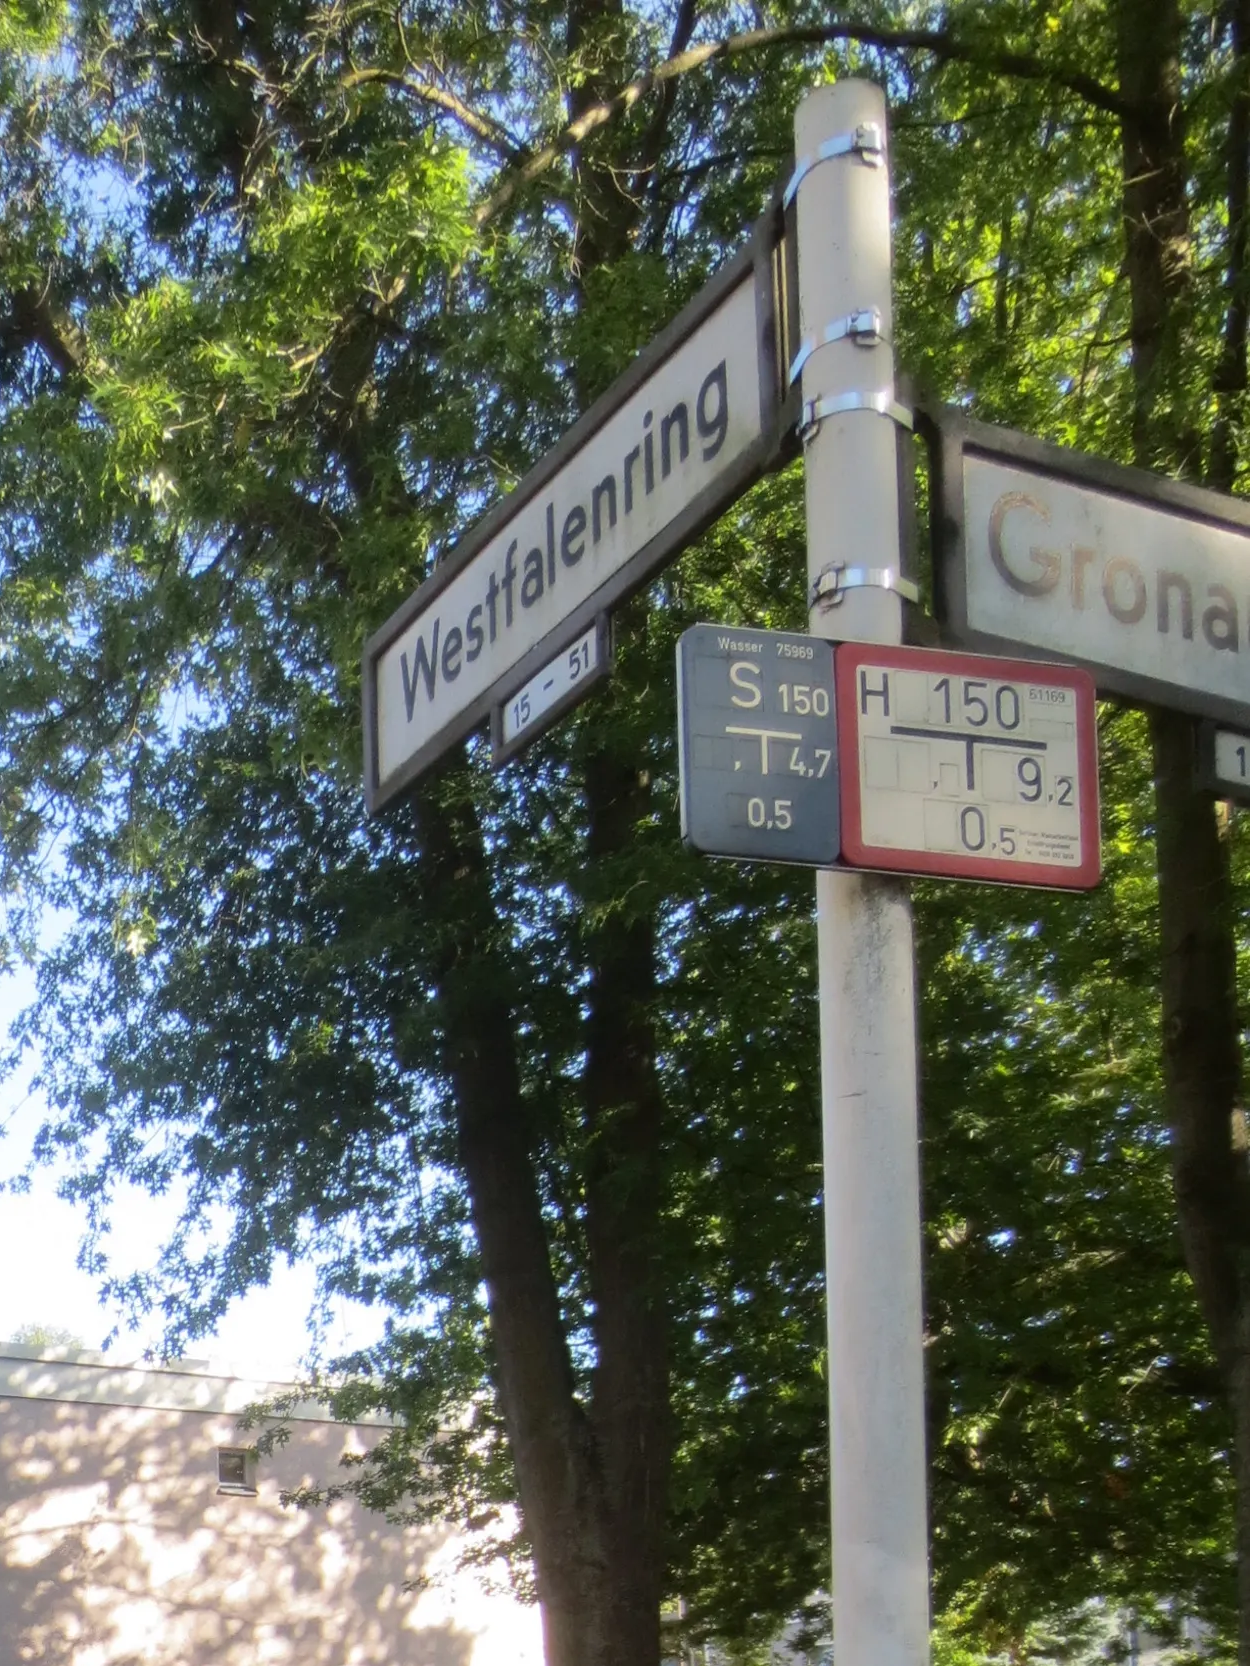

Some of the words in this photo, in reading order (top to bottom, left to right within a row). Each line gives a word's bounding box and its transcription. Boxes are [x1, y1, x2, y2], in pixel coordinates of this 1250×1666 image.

[400, 358, 729, 724] Westfalenring
[988, 490, 1250, 654] Grona
[717, 635, 764, 654] Wasser
[776, 642, 814, 660] 75969
[513, 692, 531, 729] 15
[568, 640, 590, 681] 51
[729, 661, 762, 709] S
[778, 683, 830, 717] 150
[860, 670, 890, 717] H
[933, 677, 1021, 731] 150
[789, 746, 831, 778] 4,7
[1017, 756, 1074, 807] 9,2
[747, 797, 793, 831] 0,5
[960, 805, 1017, 856] 0,5
